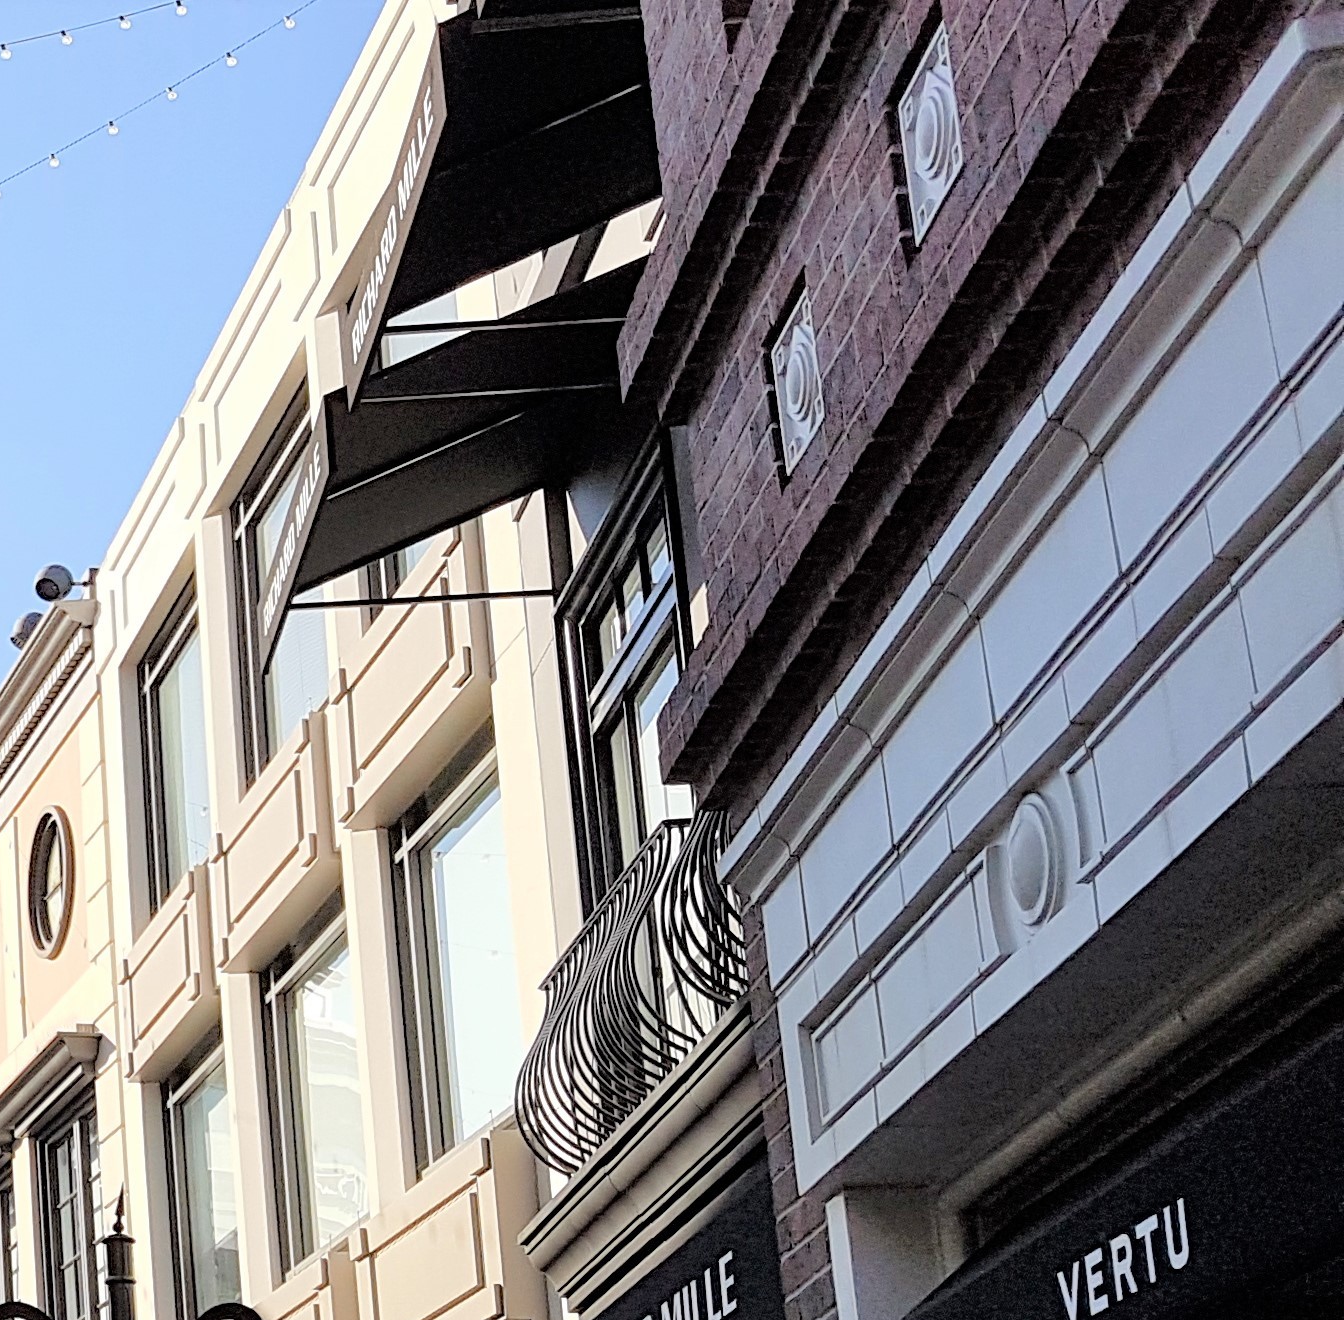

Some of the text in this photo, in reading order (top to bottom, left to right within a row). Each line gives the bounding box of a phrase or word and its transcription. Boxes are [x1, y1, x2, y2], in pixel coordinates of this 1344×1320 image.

[351, 86, 434, 365] RICHARD MILLE
[262, 441, 321, 636] RICHARD MILLE
